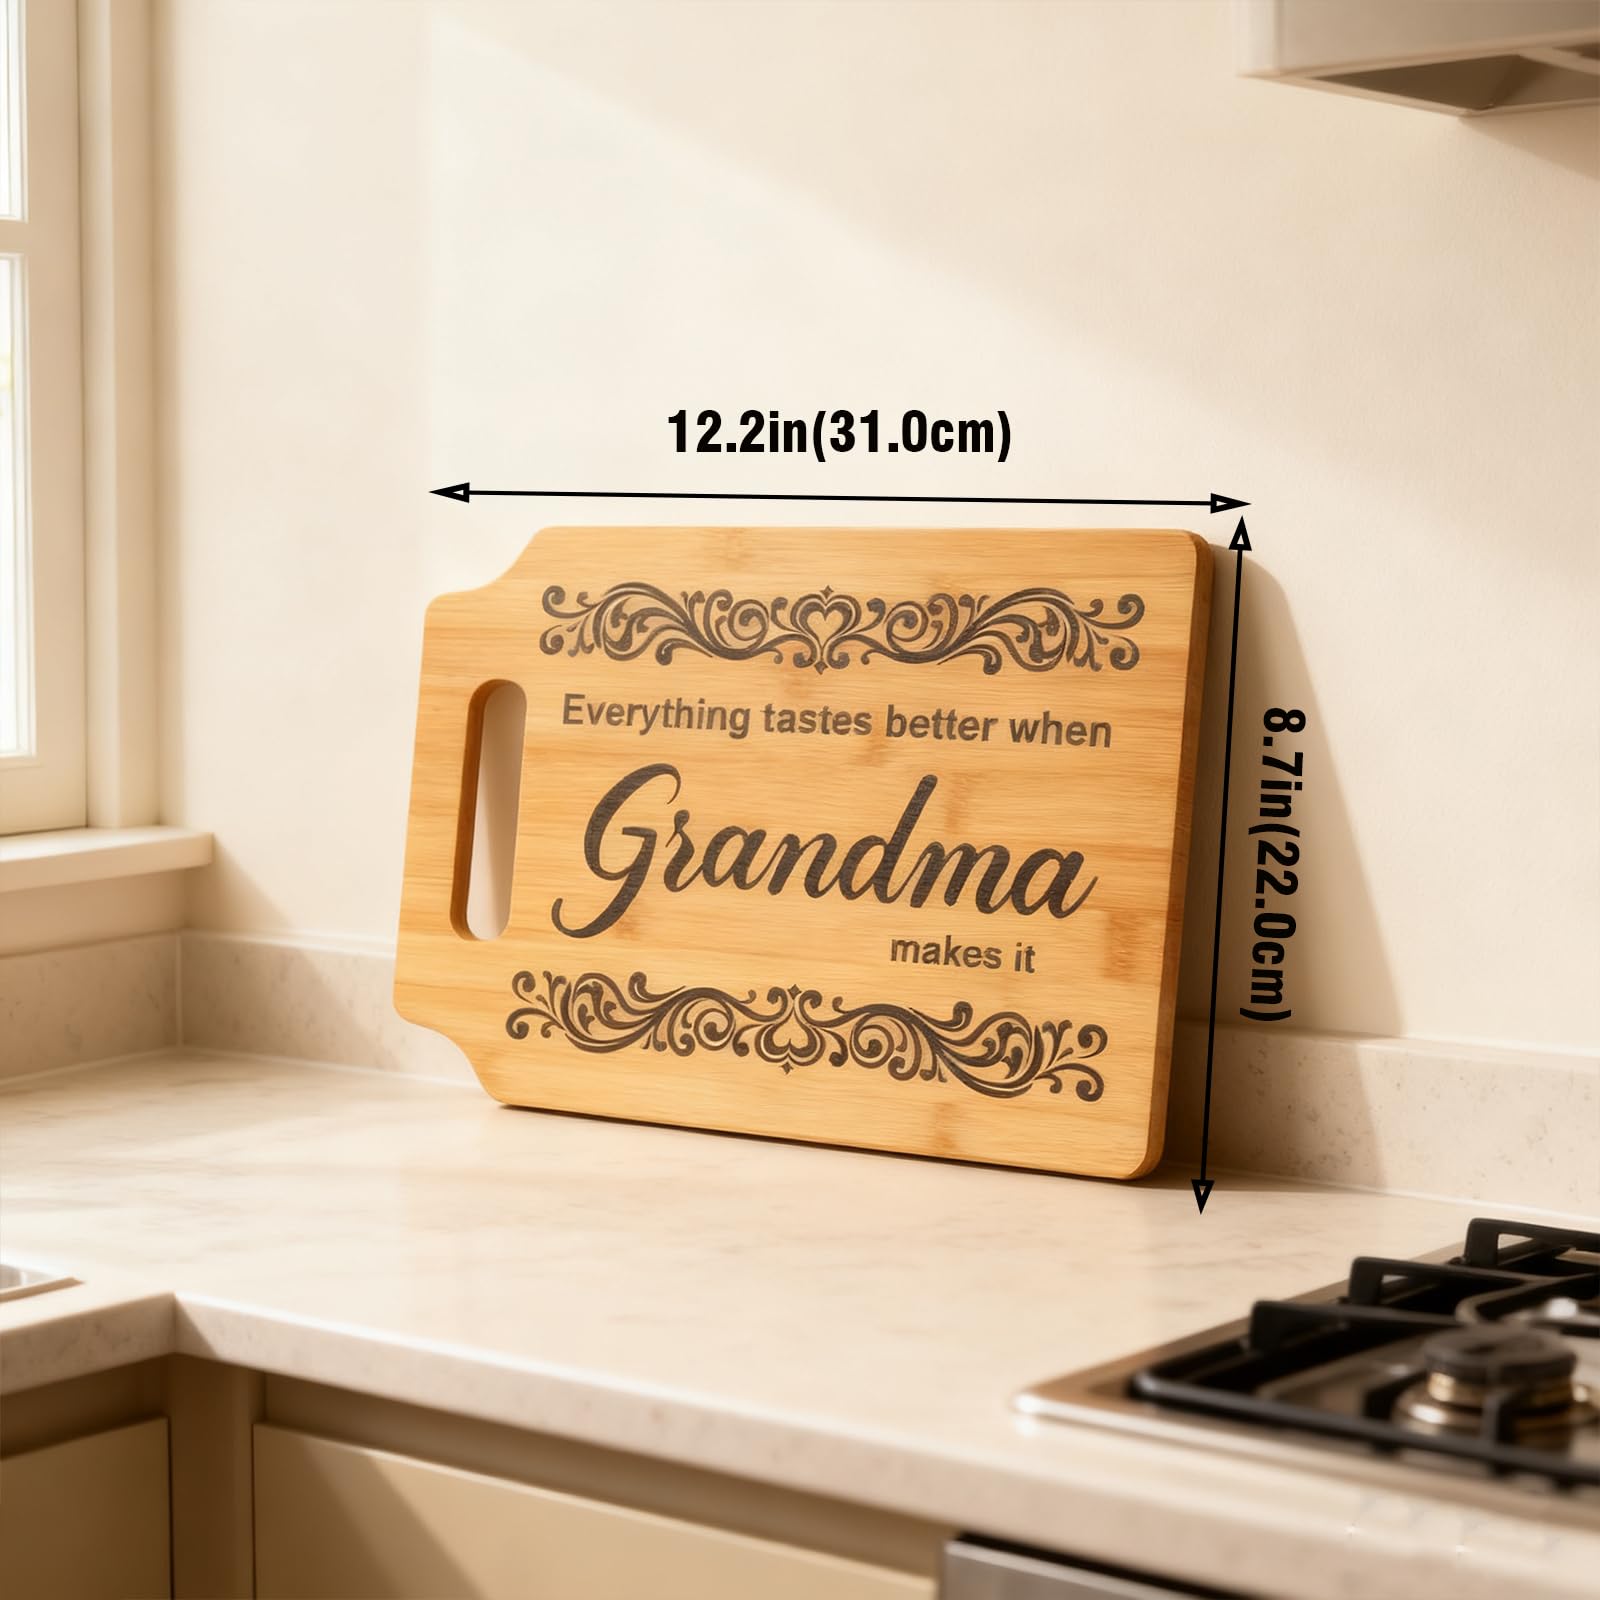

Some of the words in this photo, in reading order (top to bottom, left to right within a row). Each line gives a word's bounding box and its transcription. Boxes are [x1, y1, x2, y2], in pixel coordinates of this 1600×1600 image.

[563, 693, 750, 738] Everything
[764, 703, 873, 736] tastes
[885, 704, 998, 743] better
[1009, 712, 1112, 748] when
[551, 763, 1098, 939] Grandma
[891, 935, 1003, 970] makes
[1013, 940, 1037, 974] it
